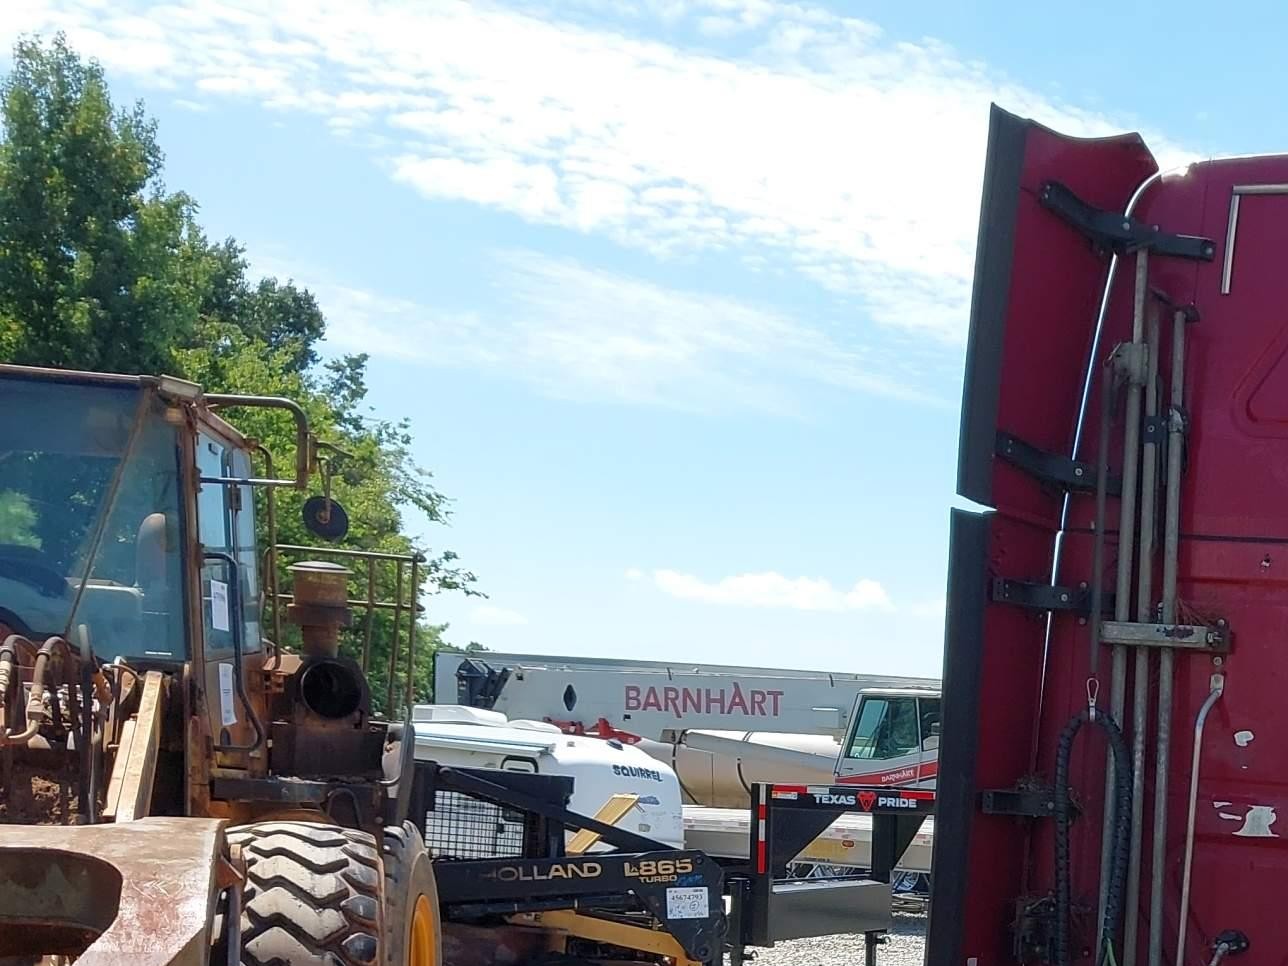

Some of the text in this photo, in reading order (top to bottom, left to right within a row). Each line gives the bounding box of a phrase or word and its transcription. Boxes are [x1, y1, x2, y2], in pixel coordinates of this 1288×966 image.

[625, 682, 784, 718] BARNHART
[612, 764, 663, 782] SQUIRREL
[814, 794, 918, 808] TEXAS PRIDE
[639, 874, 678, 883] TURBO
